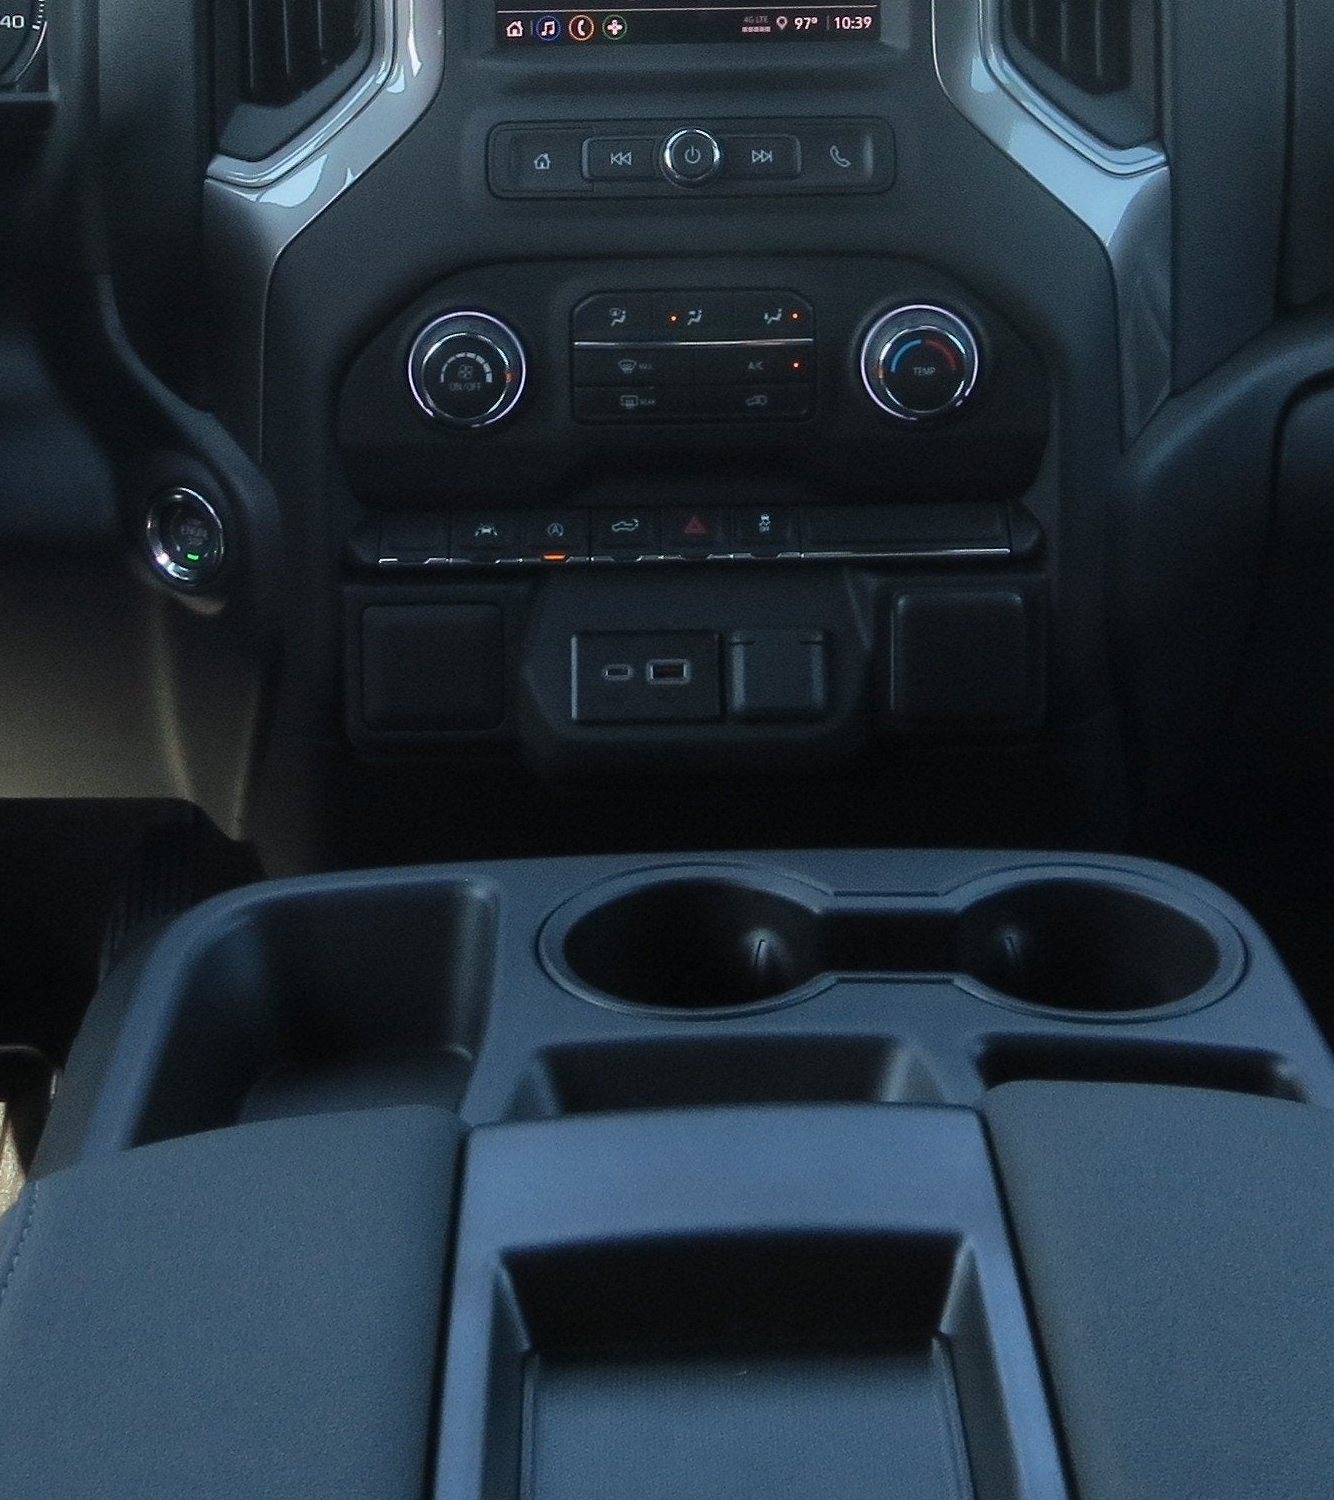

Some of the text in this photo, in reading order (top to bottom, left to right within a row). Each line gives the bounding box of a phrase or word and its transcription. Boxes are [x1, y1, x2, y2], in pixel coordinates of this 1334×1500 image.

[743, 15, 769, 24] 4G LTE
[834, 16, 872, 30] 10:39
[747, 361, 764, 370] A/C
[913, 366, 936, 376] TEMP
[449, 382, 482, 392] ON/OFF
